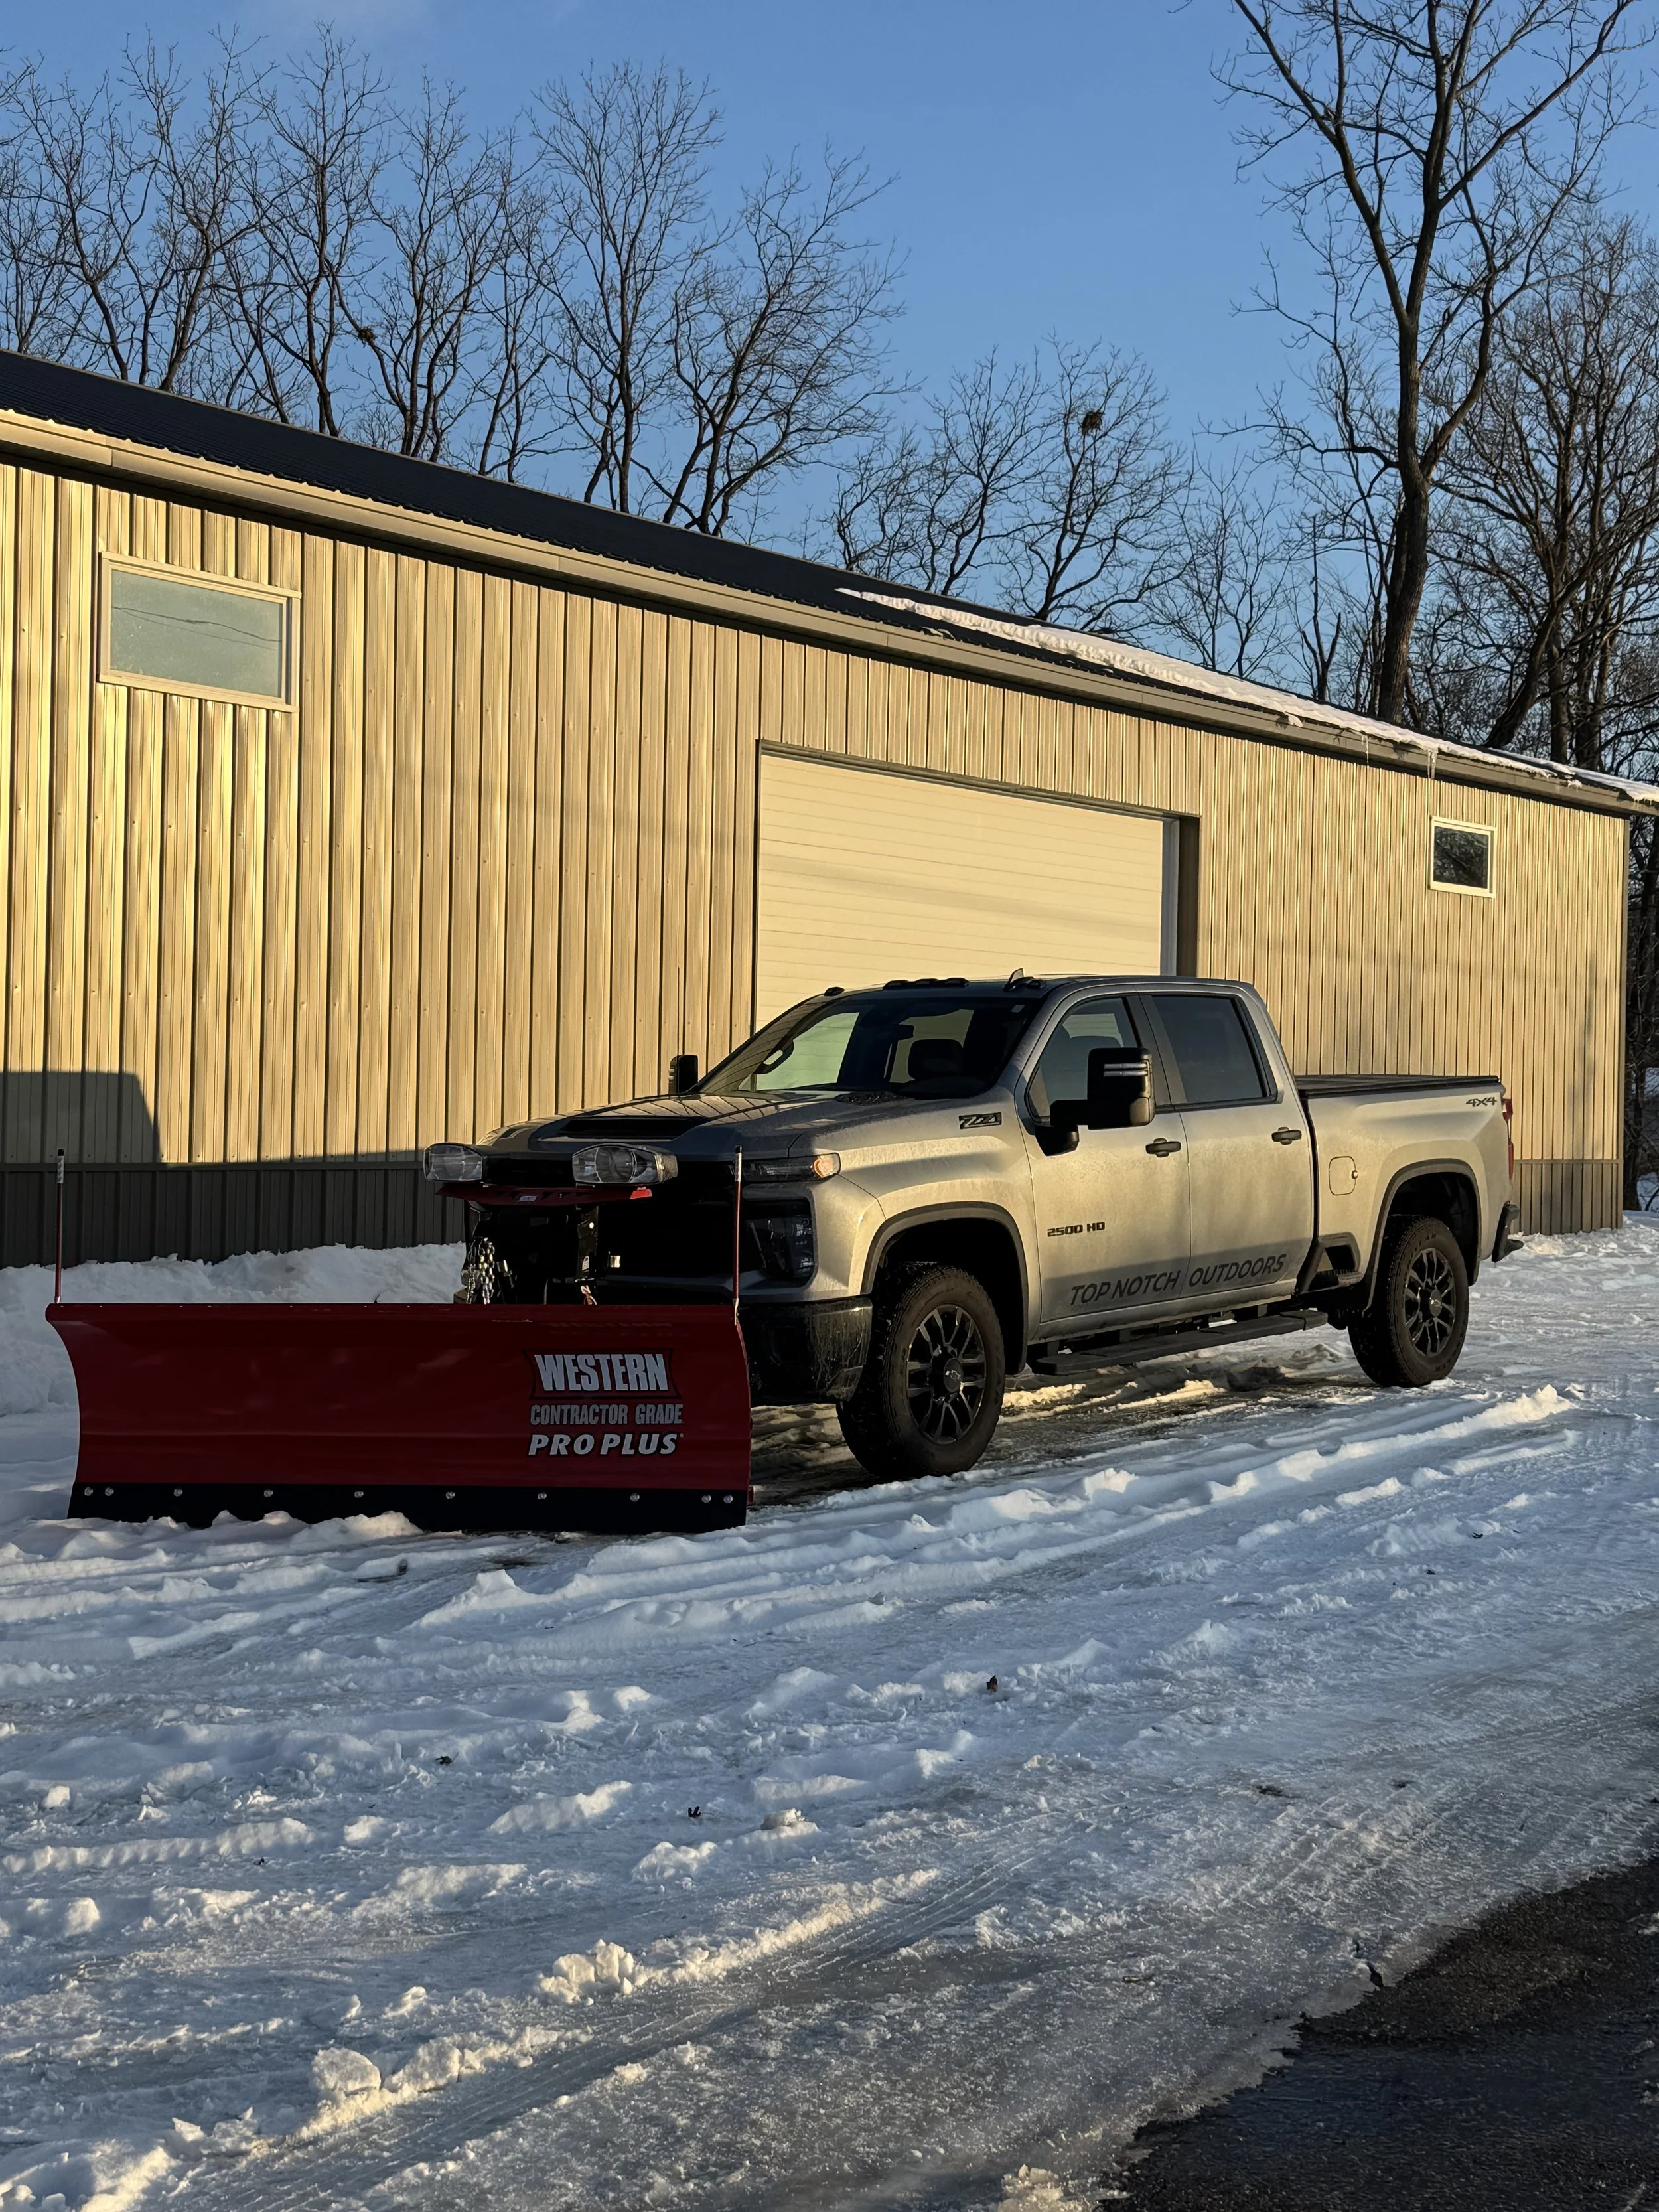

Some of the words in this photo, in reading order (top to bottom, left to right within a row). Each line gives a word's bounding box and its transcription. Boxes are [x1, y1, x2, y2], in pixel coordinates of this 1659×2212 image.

[1047, 1225, 1083, 1237] 2500
[1086, 1222, 1105, 1232] HD
[1070, 1285, 1112, 1305] TOP
[1111, 1270, 1181, 1299] NOTCH
[1189, 1254, 1287, 1287] OUTDOORS
[534, 1354, 668, 1391] WESTERN
[530, 1404, 628, 1425] CONTRACTOR
[635, 1404, 684, 1424] GRADE
[528, 1434, 595, 1455] PRO
[600, 1434, 678, 1455] PLUS
